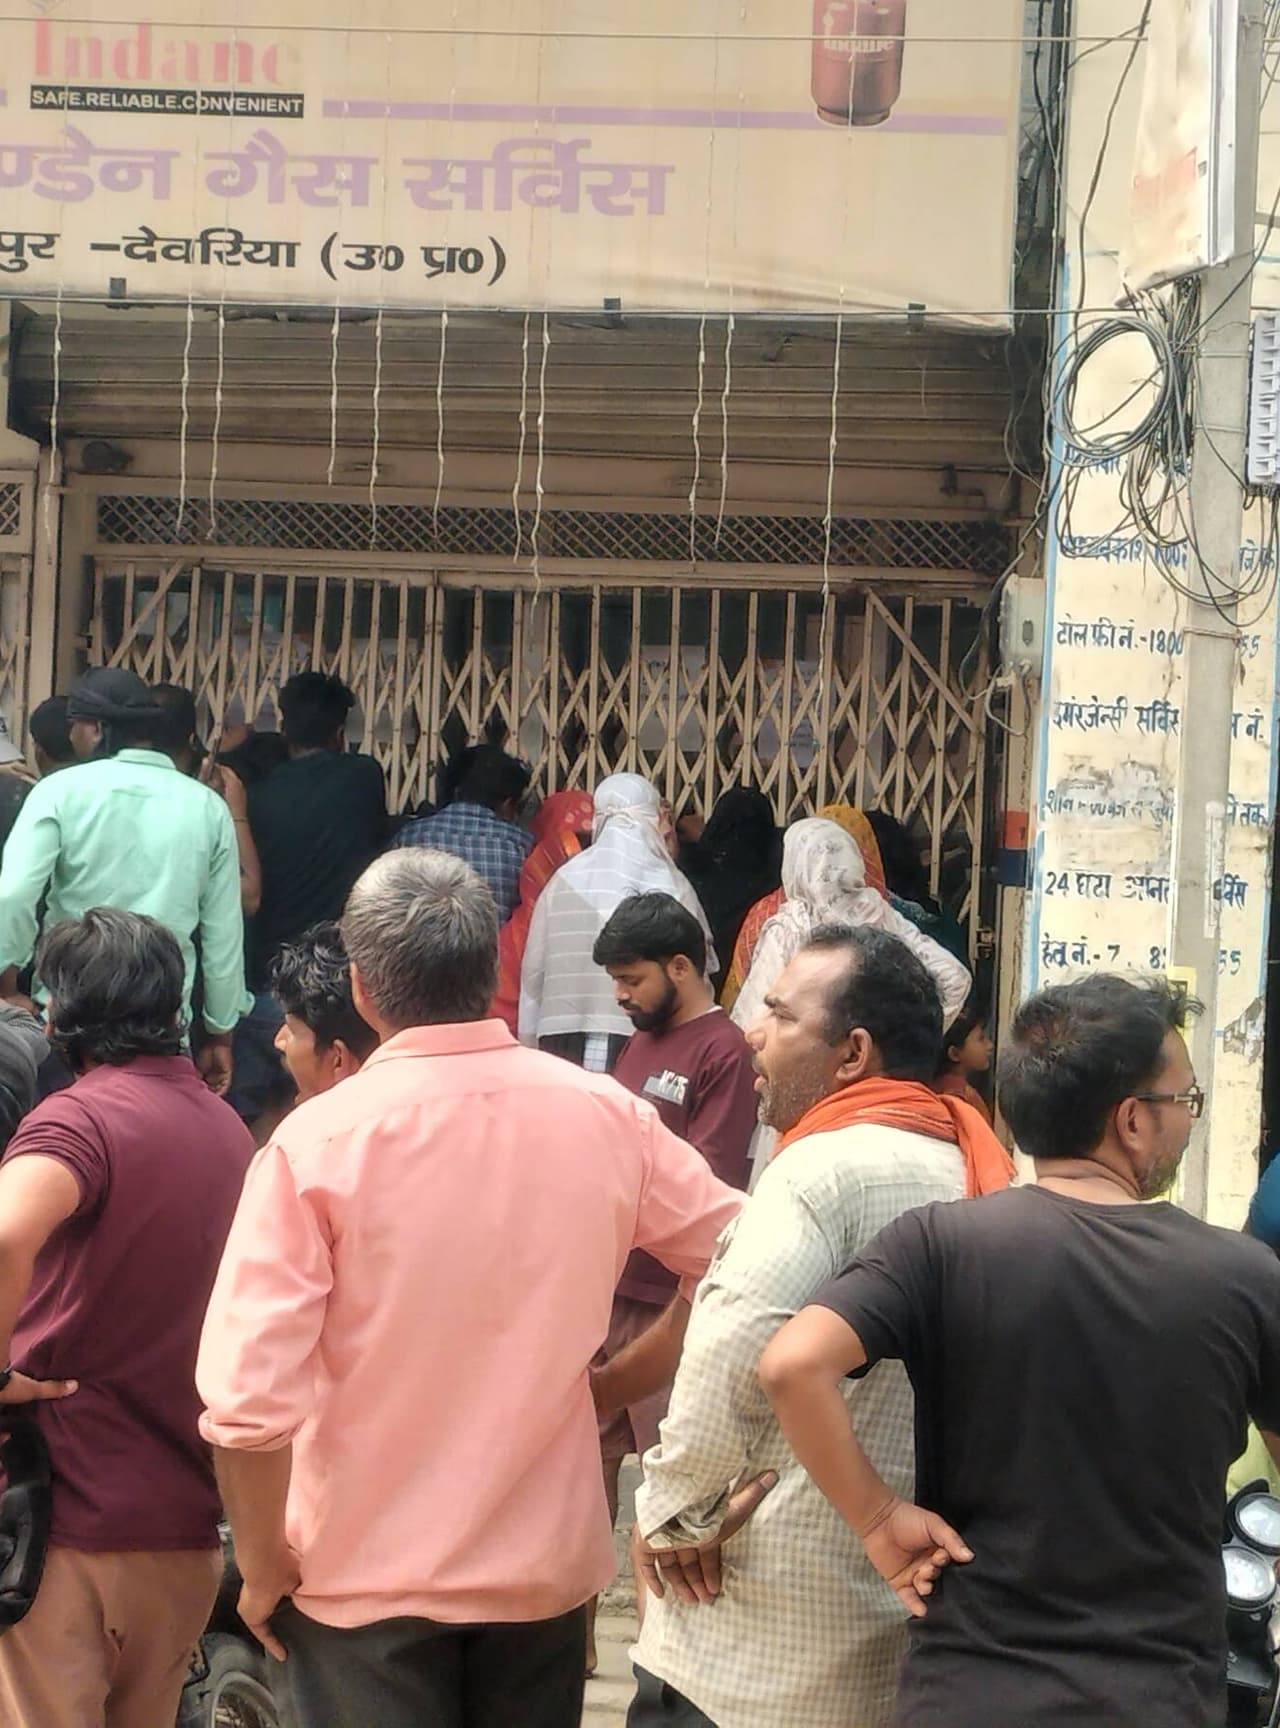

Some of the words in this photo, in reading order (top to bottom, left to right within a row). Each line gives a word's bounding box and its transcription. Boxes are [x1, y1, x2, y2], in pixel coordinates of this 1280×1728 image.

[205, 129, 378, 209] गैस
[404, 139, 675, 217] सर्विस
[1056, 613, 1088, 647] टोल
[1044, 871, 1069, 897] 24
